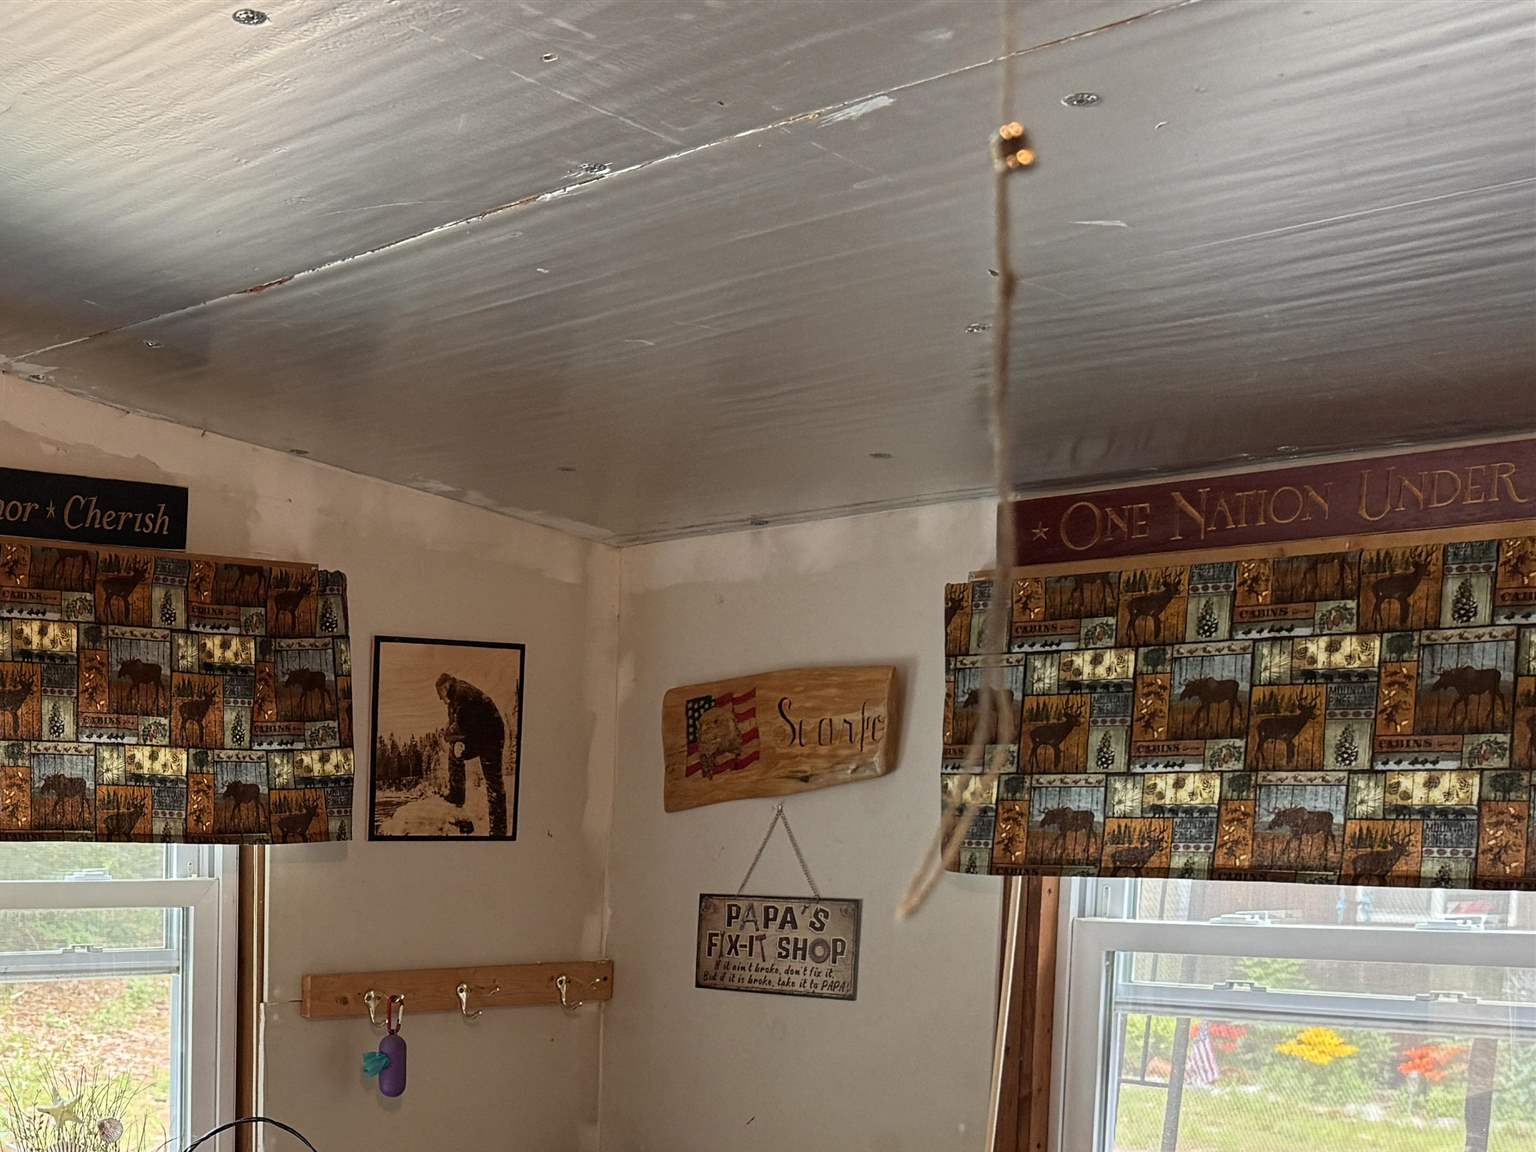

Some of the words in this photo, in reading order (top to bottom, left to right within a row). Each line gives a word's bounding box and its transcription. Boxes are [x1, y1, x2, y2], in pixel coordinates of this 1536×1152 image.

[64, 494, 170, 535] Cherish
[1061, 502, 1151, 551] ONE
[1170, 482, 1333, 541] NATION
[1360, 462, 1529, 522] UNDER
[726, 903, 830, 932] PAPA'S
[707, 931, 767, 962] FIX-IT
[777, 936, 847, 964] SHOP
[732, 961, 753, 972] ain't
[784, 965, 807, 976] don't
[810, 967, 822, 977] fix
[737, 974, 745, 983] is
[778, 976, 796, 987] take
[799, 978, 807, 988] it
[810, 979, 818, 989] to
[821, 979, 849, 992] PAPA!
